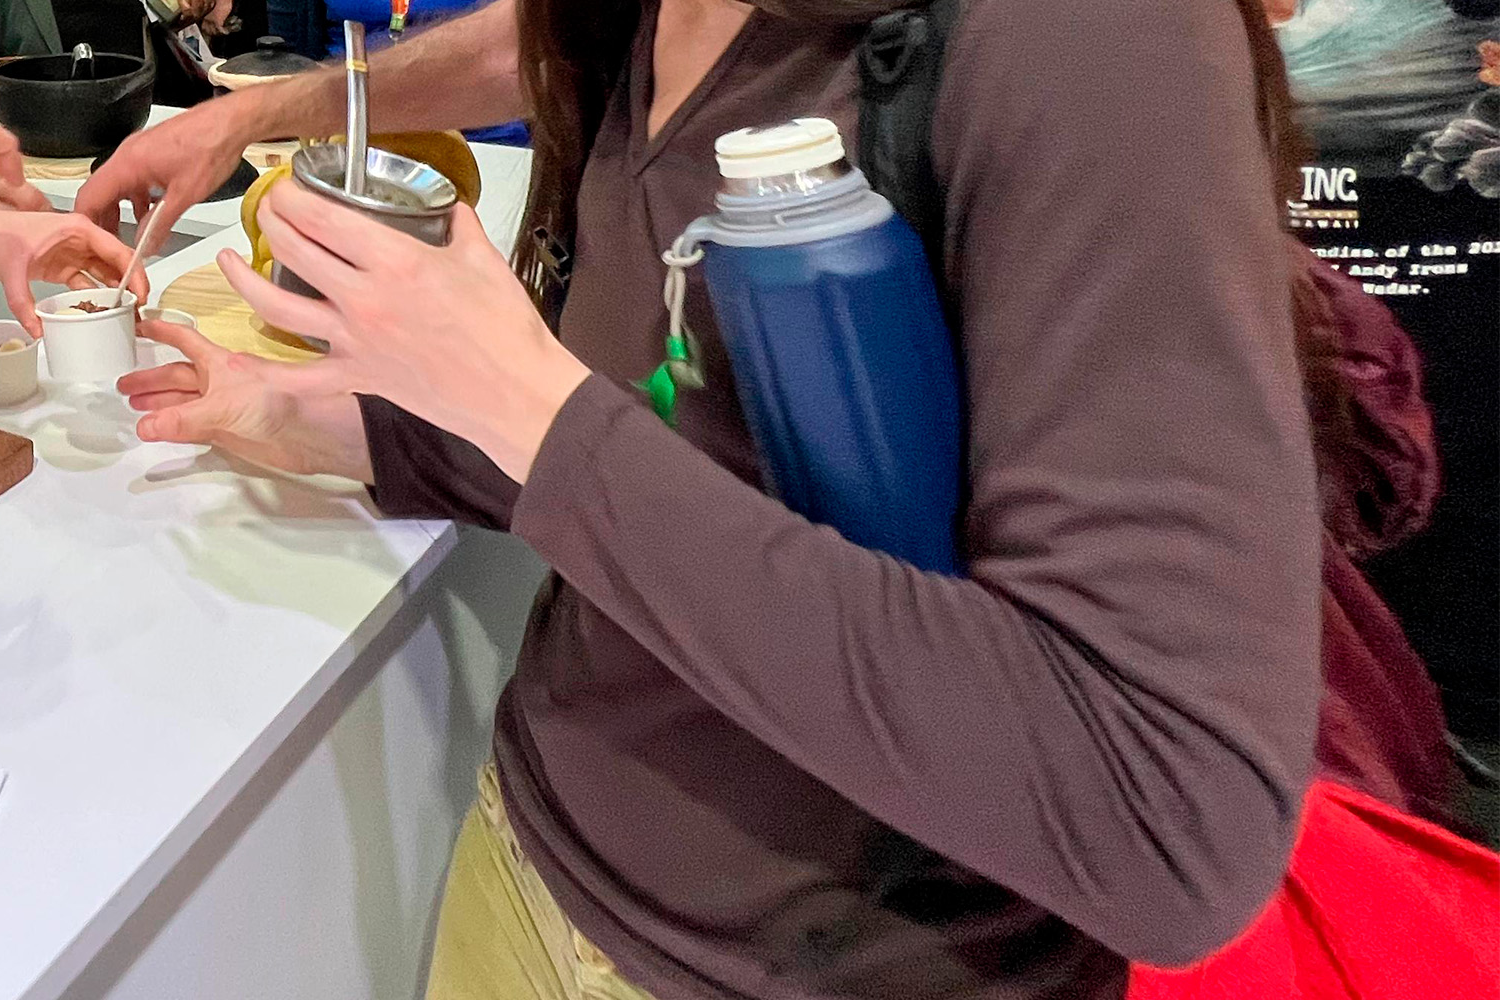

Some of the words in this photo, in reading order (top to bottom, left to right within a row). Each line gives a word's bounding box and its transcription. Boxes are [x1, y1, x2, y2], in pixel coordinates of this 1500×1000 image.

[1385, 245, 1410, 258] of
[1421, 244, 1457, 257] the
[1348, 264, 1399, 279] Andy
